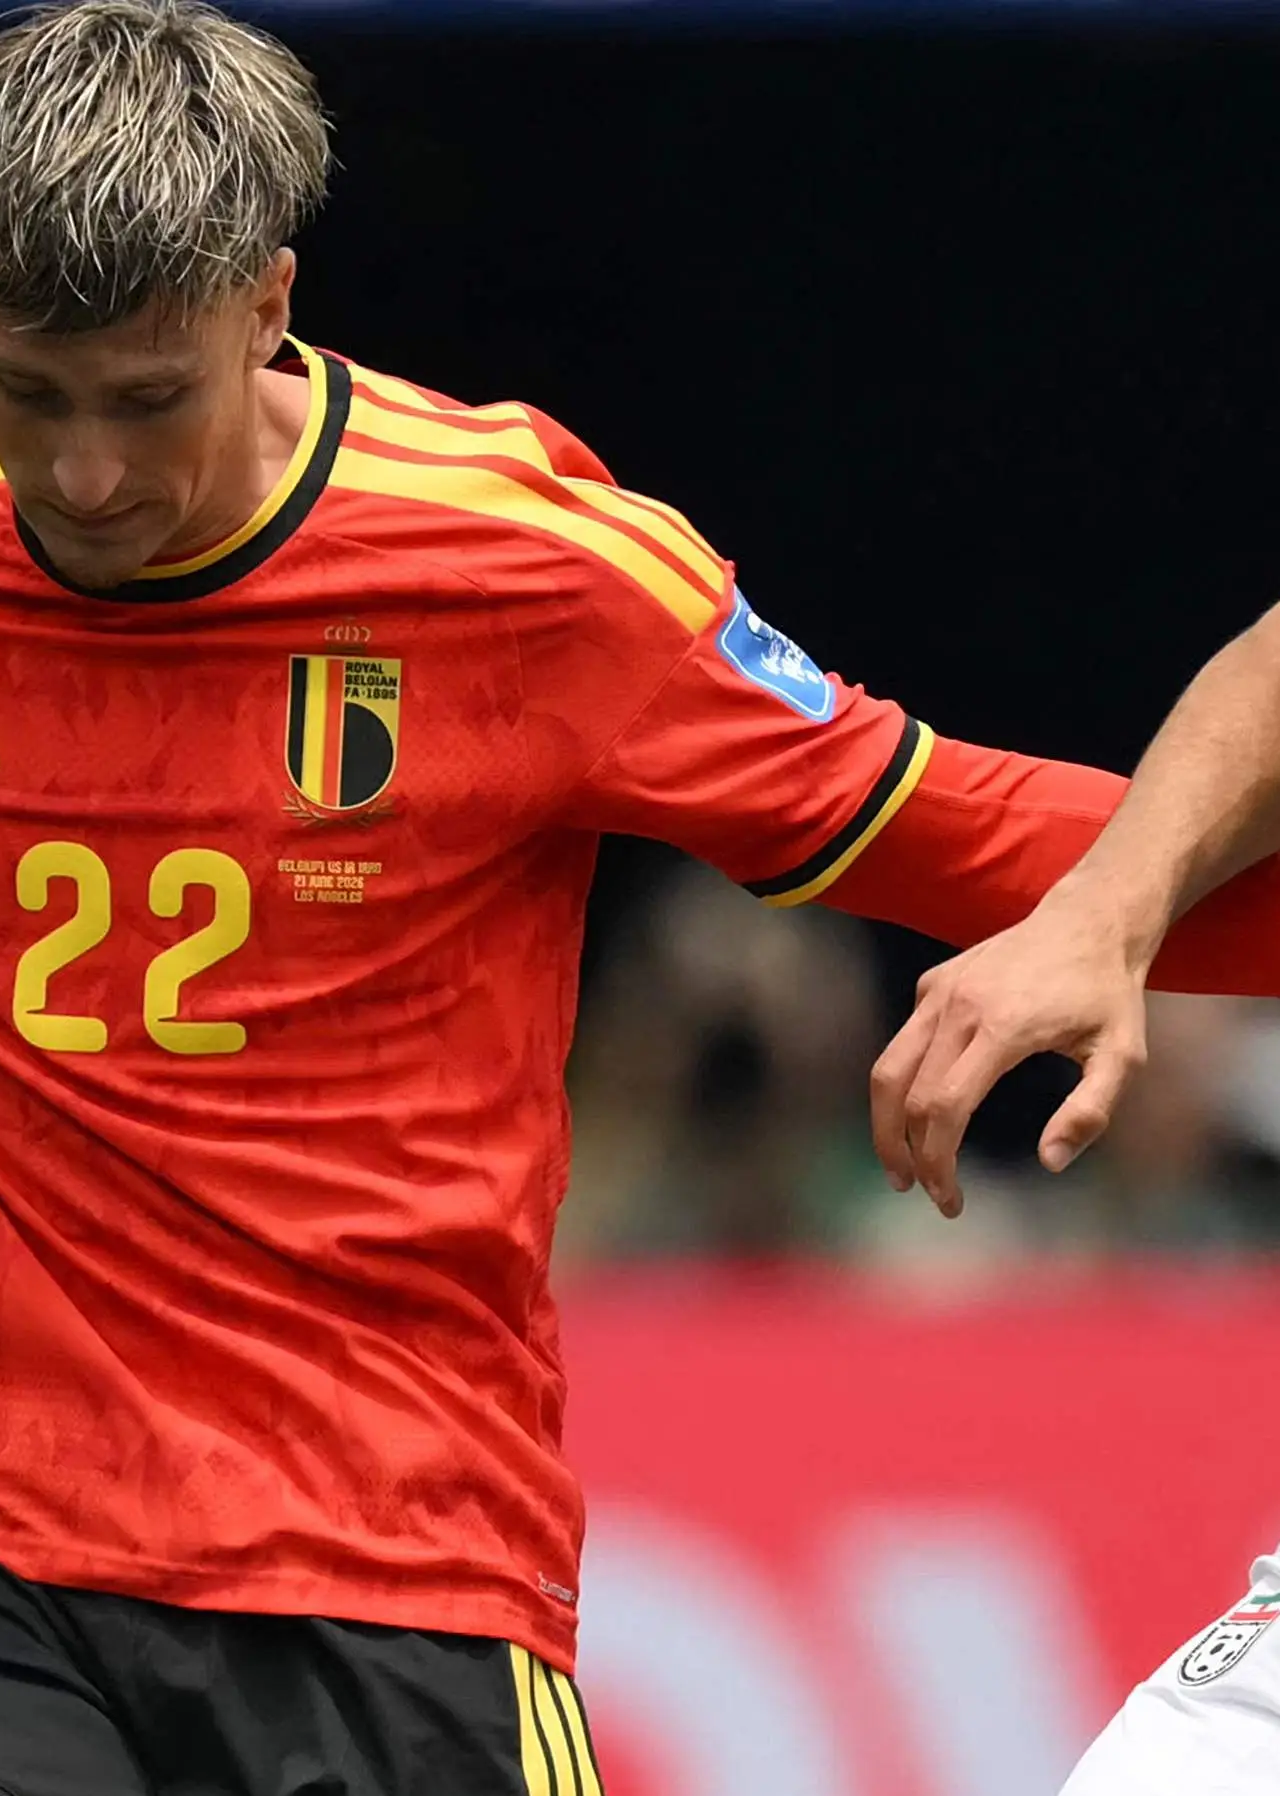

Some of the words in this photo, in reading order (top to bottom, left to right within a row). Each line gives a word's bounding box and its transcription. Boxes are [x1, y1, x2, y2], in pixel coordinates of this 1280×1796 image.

[345, 661, 384, 674] ROYAL
[345, 674, 398, 687] BELGIAN
[337, 876, 364, 889] 2026
[13, 841, 251, 1055] 22
